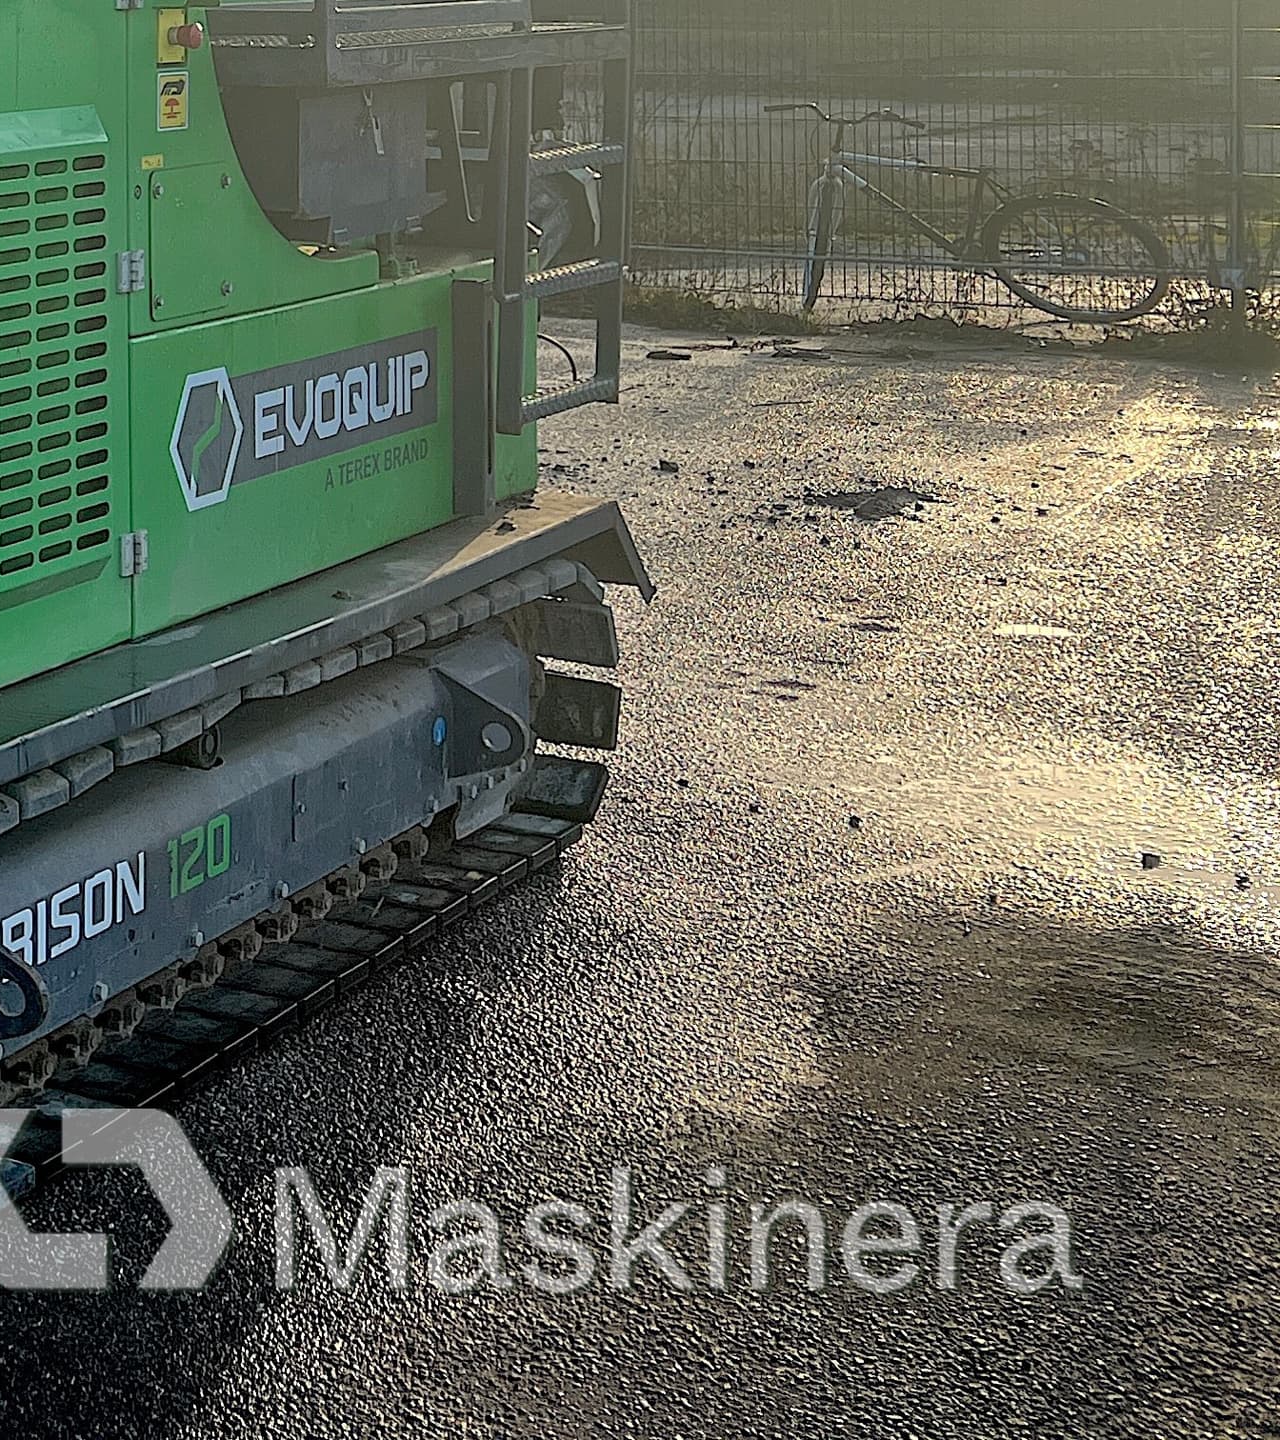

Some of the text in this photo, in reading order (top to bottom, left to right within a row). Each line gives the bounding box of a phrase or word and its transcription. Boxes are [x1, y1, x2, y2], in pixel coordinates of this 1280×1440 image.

[253, 349, 430, 459] EVOQUIP
[324, 438, 429, 491] A TEREX BRAND
[1, 812, 231, 967] BISON 120
